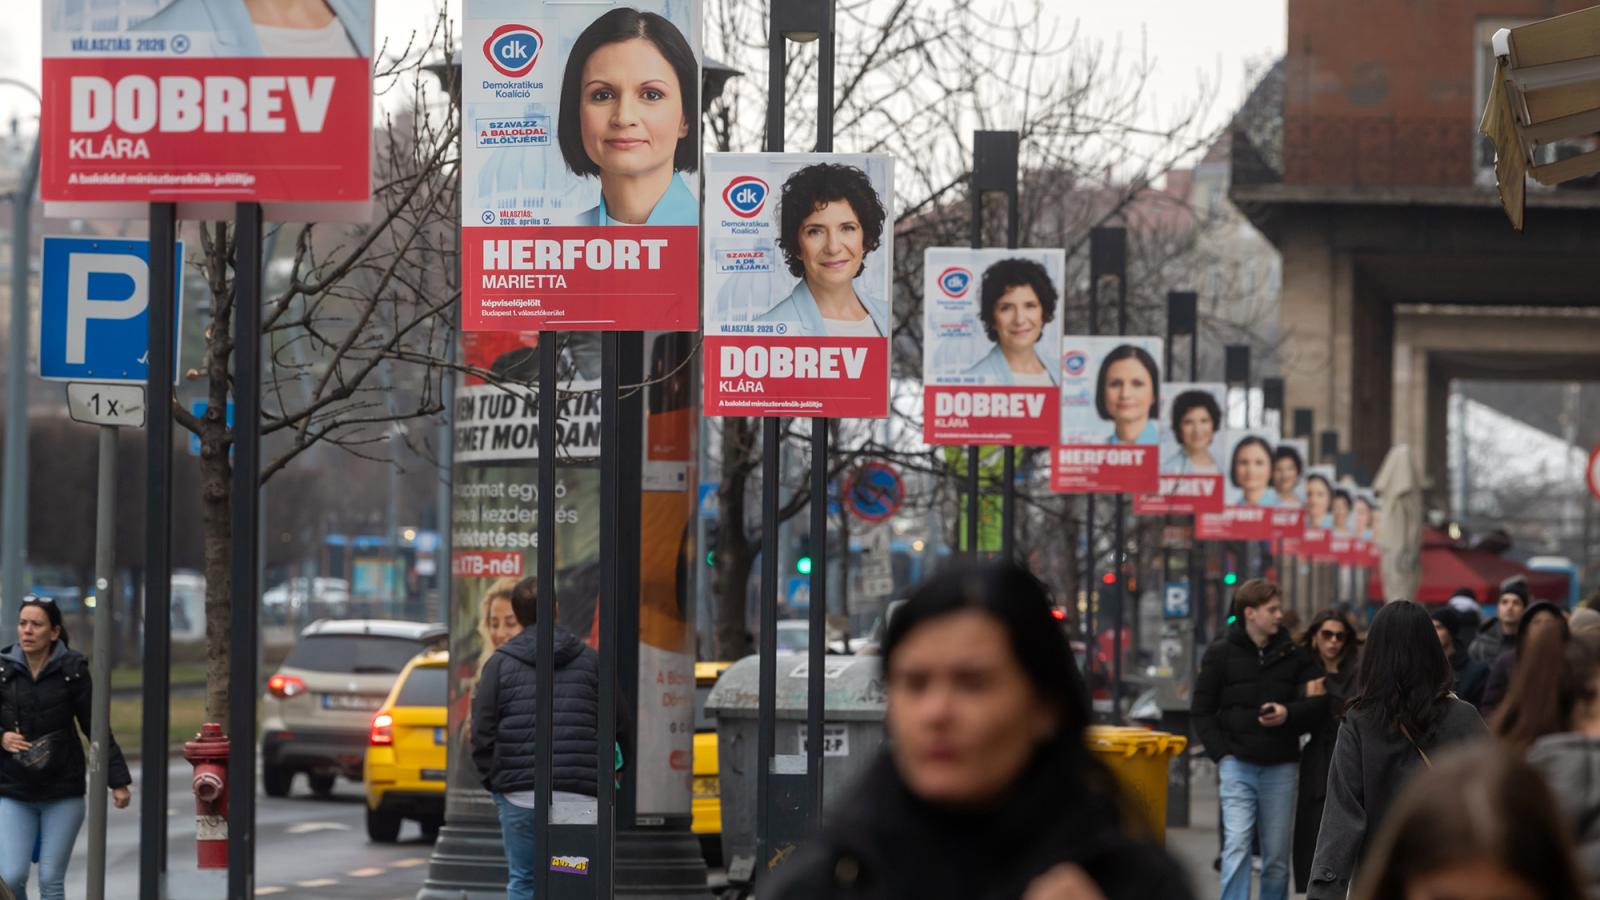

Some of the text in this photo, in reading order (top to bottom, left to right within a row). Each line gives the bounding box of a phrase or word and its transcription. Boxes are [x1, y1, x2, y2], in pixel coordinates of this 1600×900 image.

[71, 36, 131, 51] VÁLASZTÁS
[501, 41, 528, 59] dk
[482, 80, 544, 89] Demokratikus
[495, 89, 531, 98] Koalíció
[70, 75, 336, 134] DOBREV
[489, 121, 537, 129] SZAVAZZ
[490, 128, 548, 137] BALOLDAL
[69, 134, 151, 159] KLÁRA
[480, 135, 548, 145] JELÖLTJÉRE!
[736, 188, 758, 204] dk
[482, 238, 669, 271] HERFORT
[482, 274, 568, 289] MARIETTA
[65, 252, 150, 365] P
[719, 345, 869, 379] DOBREV
[719, 379, 765, 393] KLÁRA
[91, 392, 119, 417] 1 x
[478, 392, 517, 420] TUD
[934, 391, 1046, 418] DOBREV
[1058, 448, 1146, 466] HERFORT
